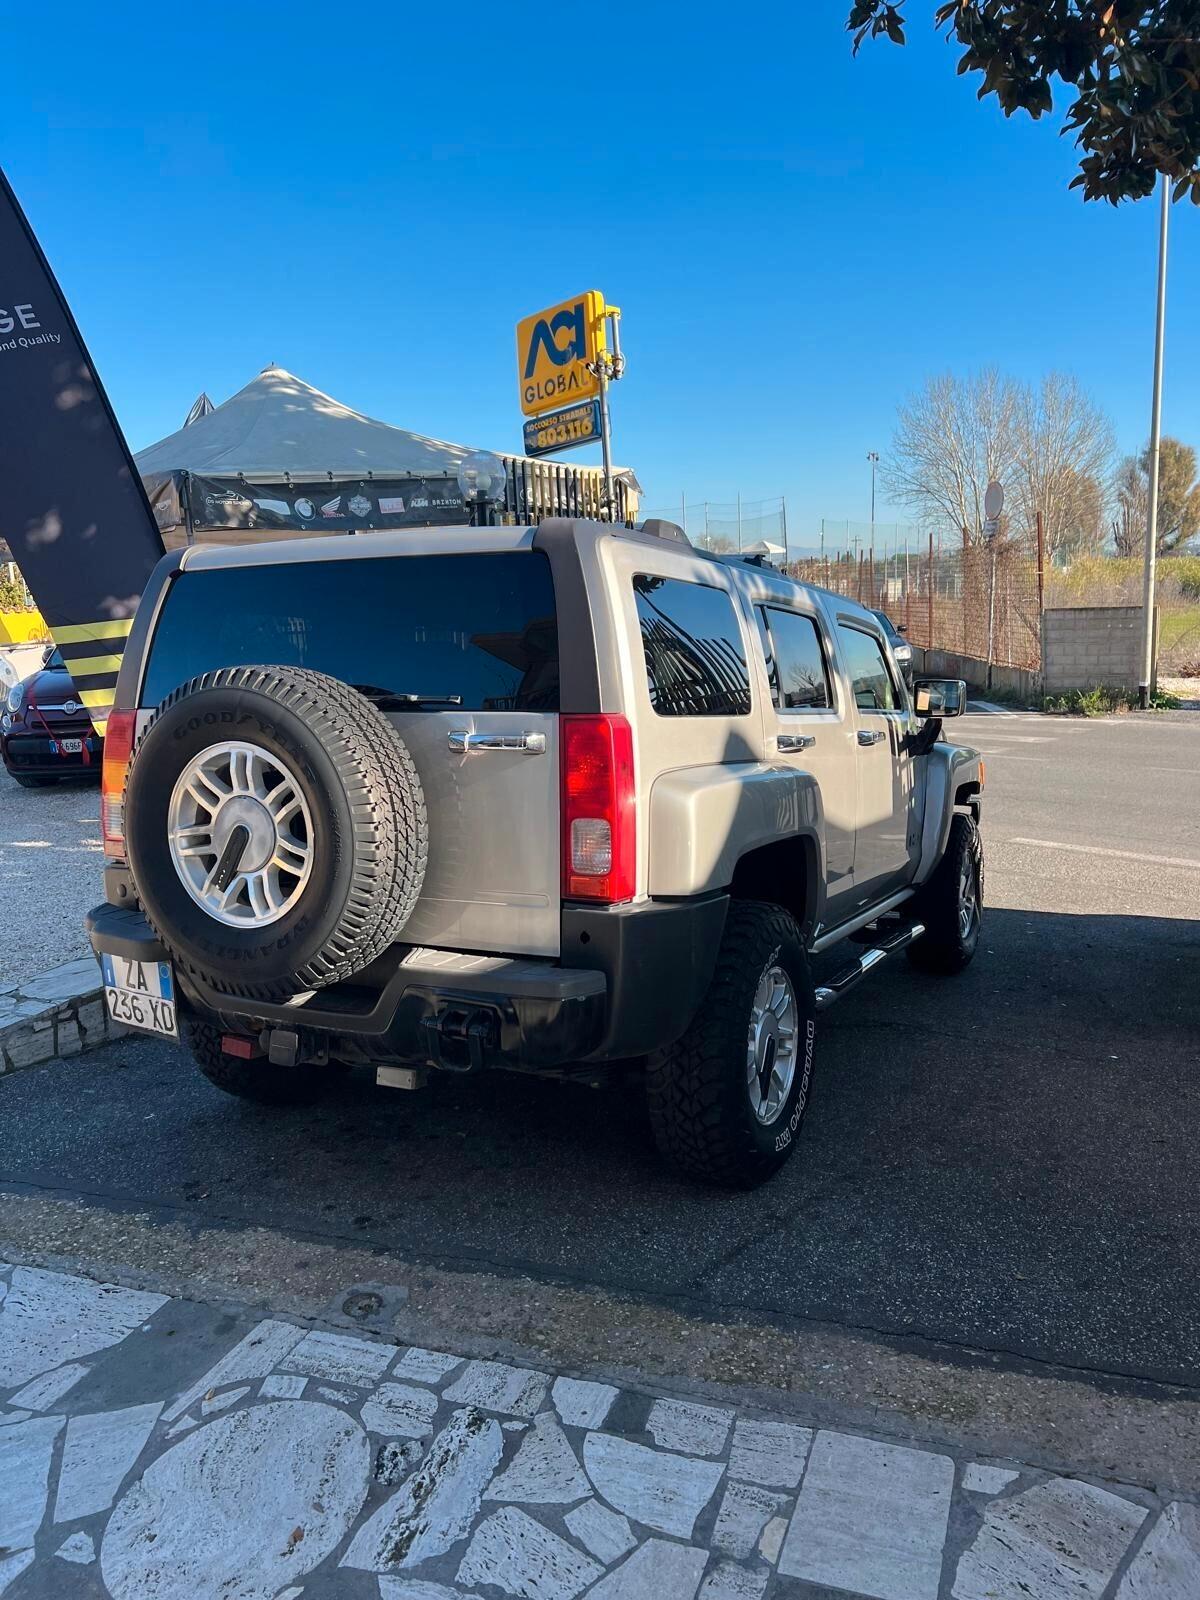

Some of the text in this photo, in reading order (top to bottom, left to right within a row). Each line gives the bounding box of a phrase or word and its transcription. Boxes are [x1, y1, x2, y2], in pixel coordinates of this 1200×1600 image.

[18, 333, 61, 348] Quality
[524, 303, 586, 379] ACI
[524, 366, 589, 404] GLOBAL
[526, 406, 593, 433] SOCCORSO STRADALE
[121, 956, 148, 991] ZA
[108, 989, 144, 1024] 236
